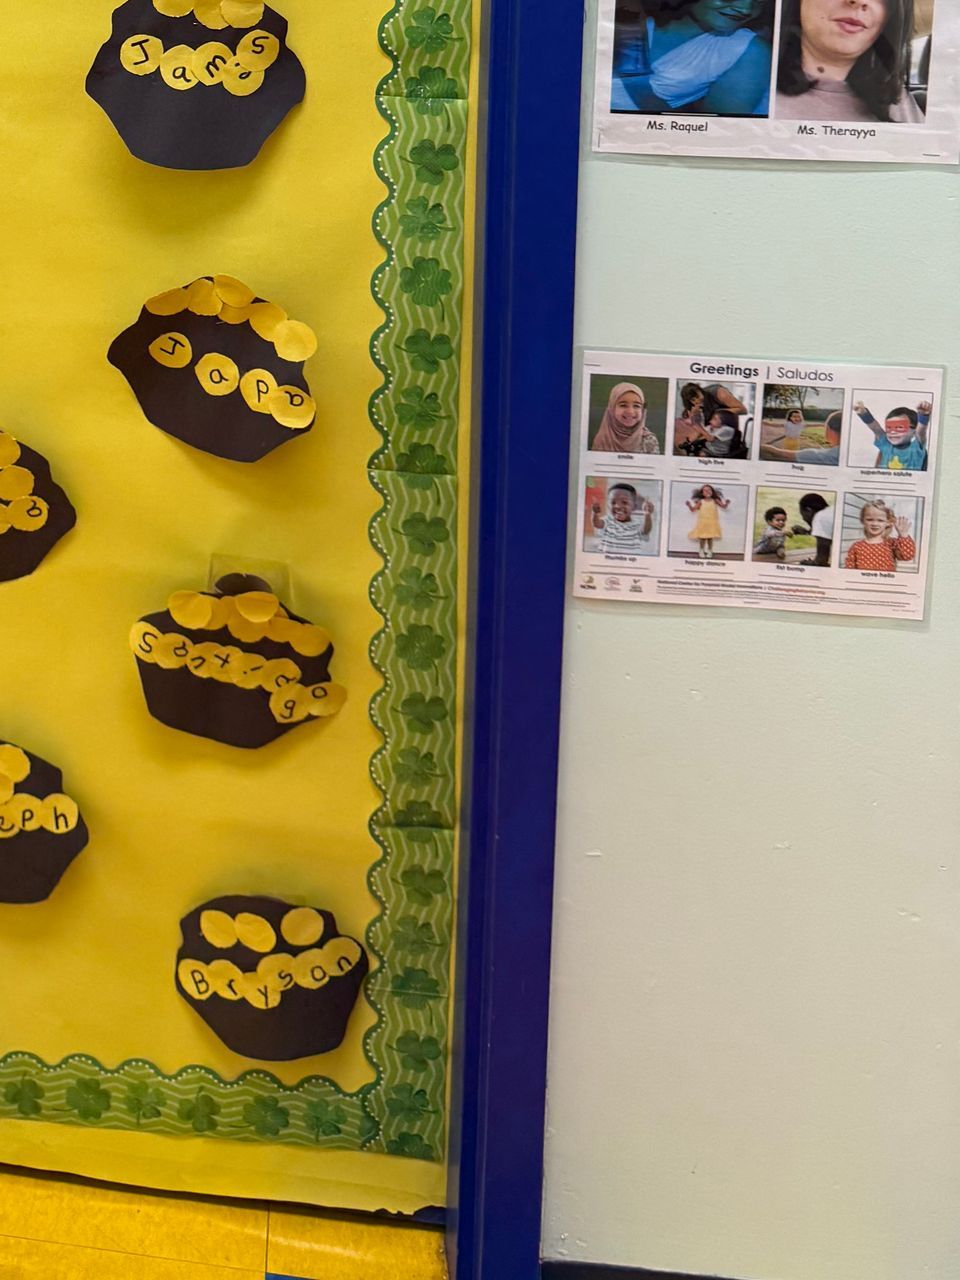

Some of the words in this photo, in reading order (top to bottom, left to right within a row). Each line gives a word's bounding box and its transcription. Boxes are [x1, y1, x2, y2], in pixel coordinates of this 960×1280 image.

[646, 120, 667, 131] Ms.
[670, 121, 709, 134] Raquel
[797, 125, 817, 136] Ms.
[821, 125, 877, 139] Therayya
[159, 336, 304, 407] Japa
[689, 361, 759, 379] Greetings
[776, 366, 835, 382] Saludos
[190, 956, 353, 1008] Bryson
